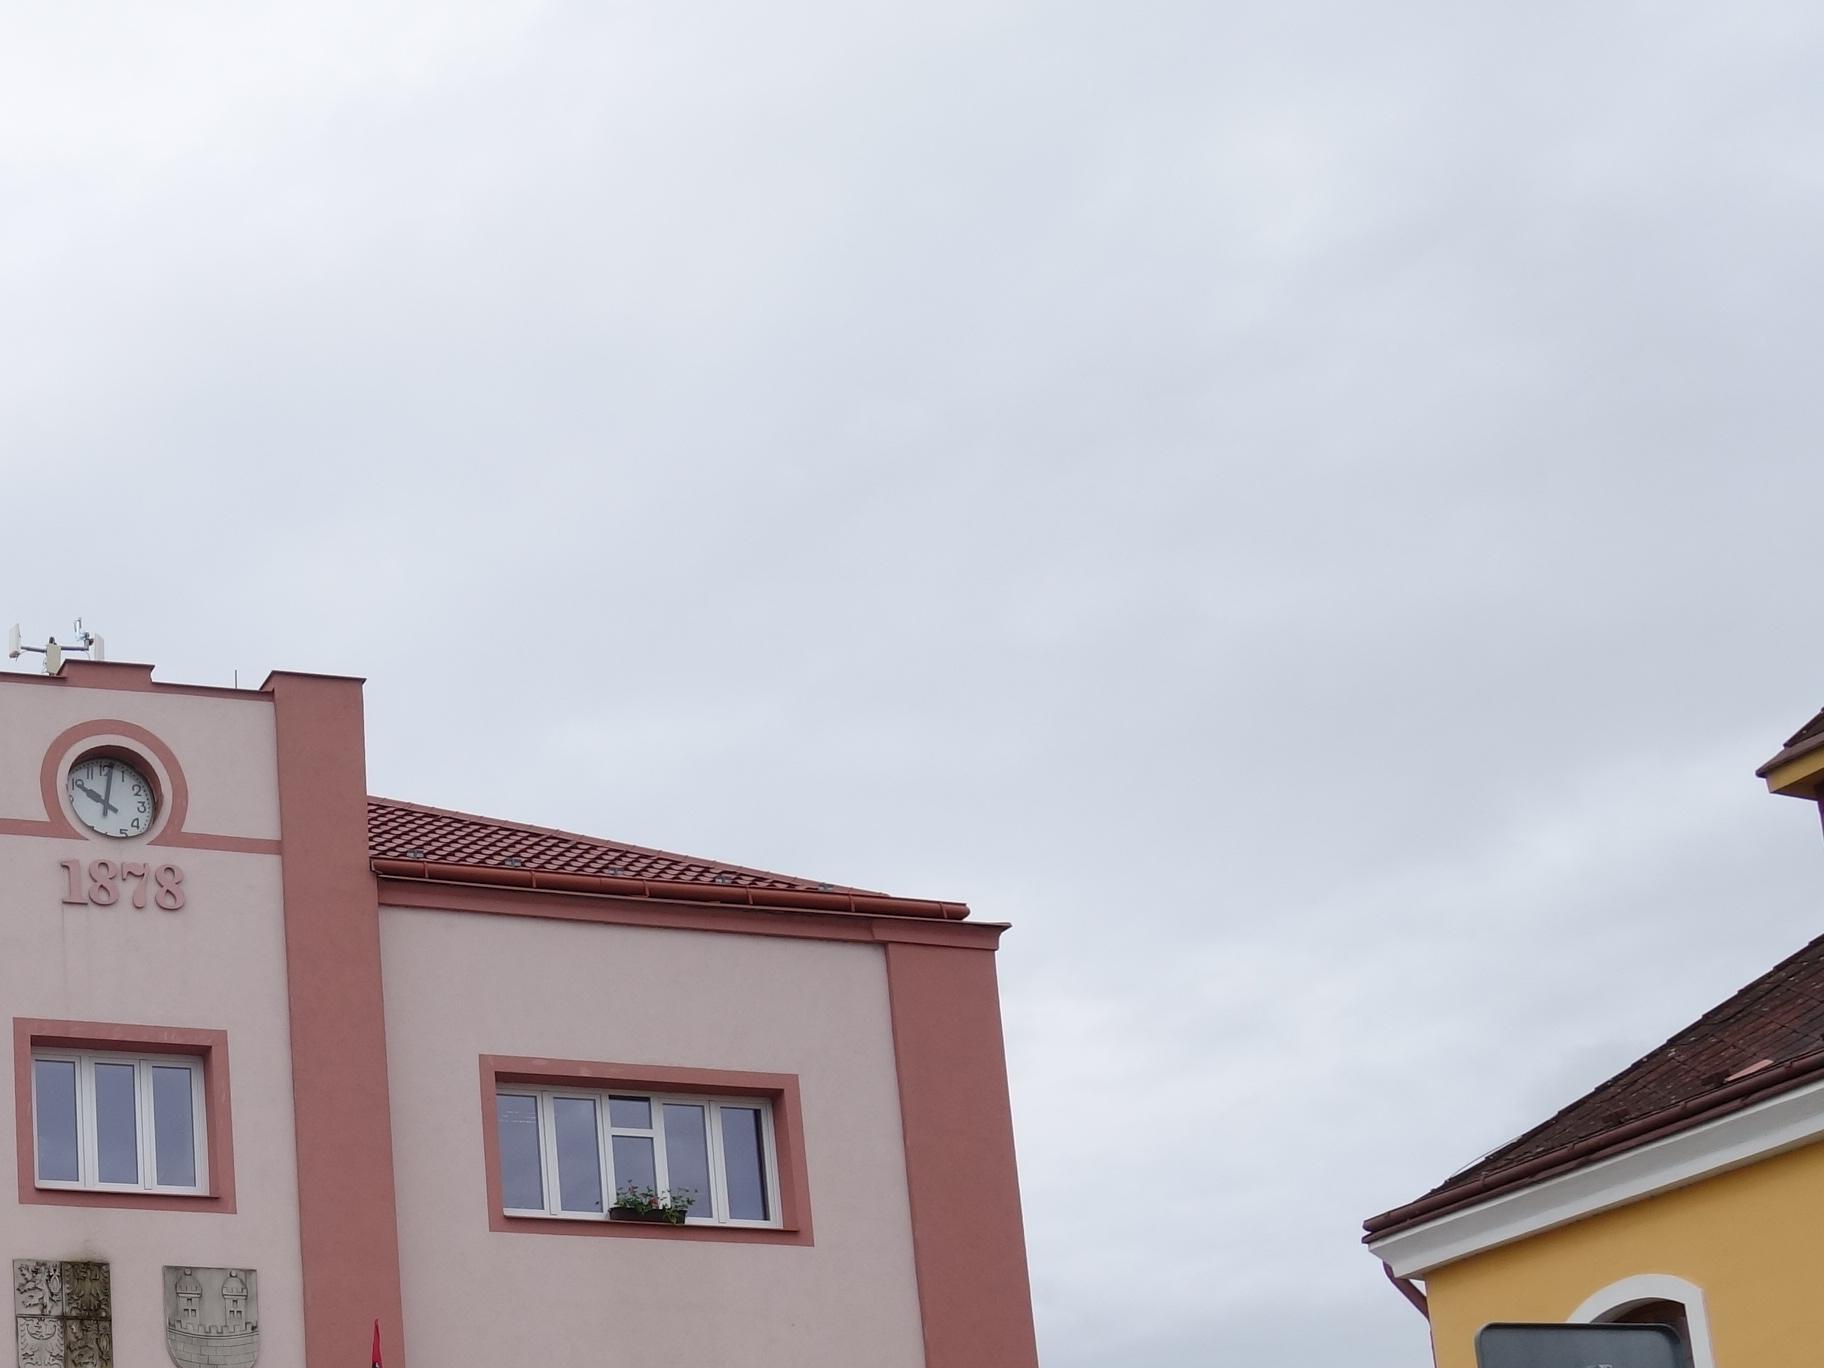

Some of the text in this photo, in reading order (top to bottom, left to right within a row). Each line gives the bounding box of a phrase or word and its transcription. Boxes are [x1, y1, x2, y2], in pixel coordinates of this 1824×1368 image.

[132, 783, 142, 797] 2
[137, 800, 147, 814] 3
[131, 817, 140, 831] 4
[60, 859, 185, 911] 1878
